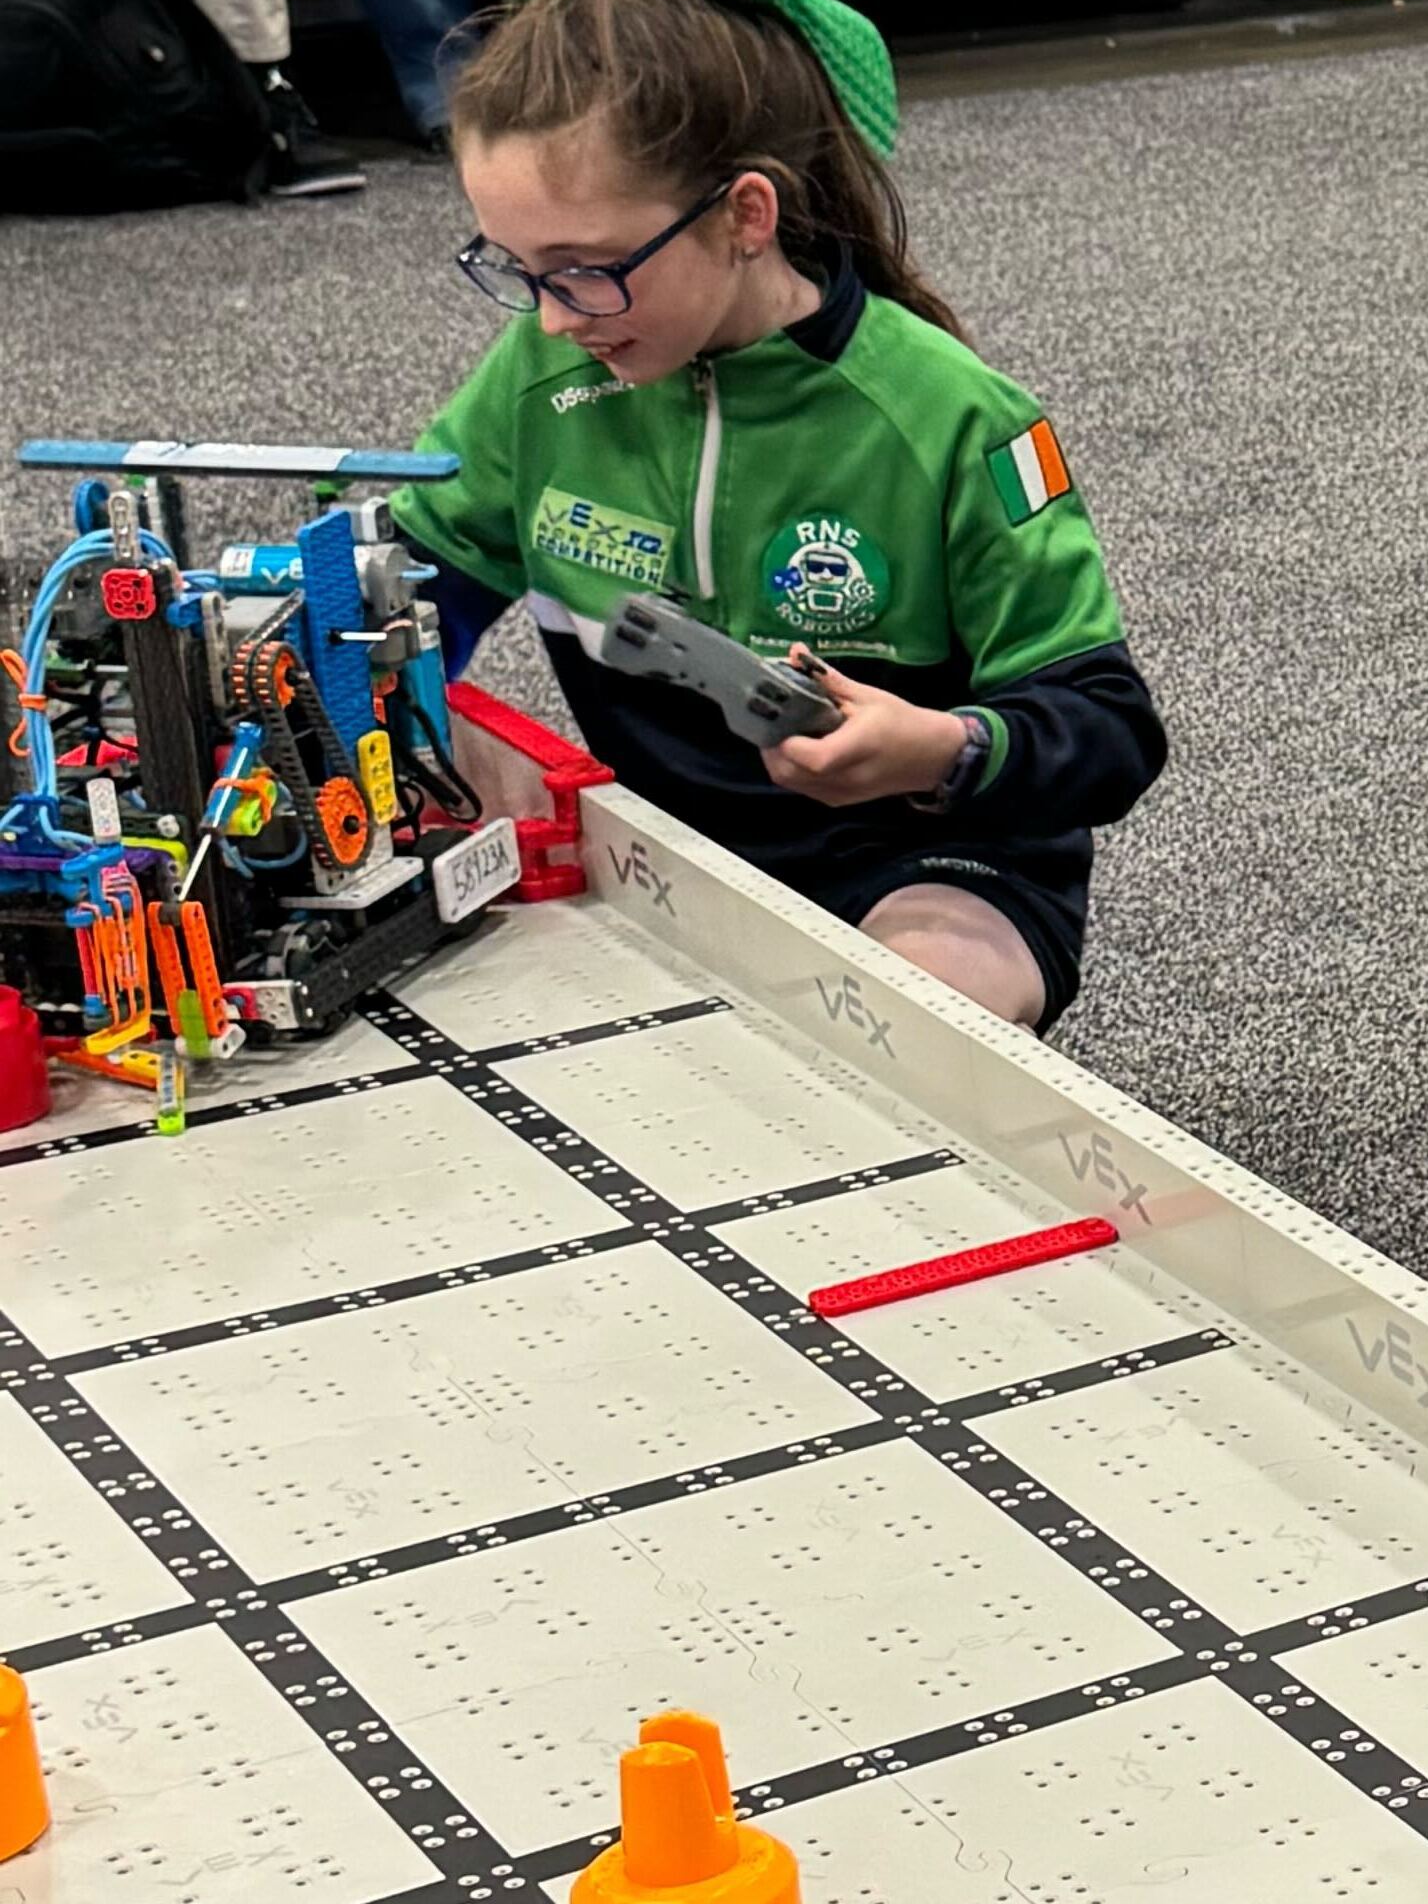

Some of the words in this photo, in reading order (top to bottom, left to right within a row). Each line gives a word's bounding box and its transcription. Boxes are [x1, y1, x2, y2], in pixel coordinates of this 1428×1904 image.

[543, 501, 622, 546] VEX
[796, 519, 861, 549] RNS
[607, 841, 677, 918] VEX
[815, 975, 895, 1059] VEX
[1057, 1131, 1152, 1226] VEX
